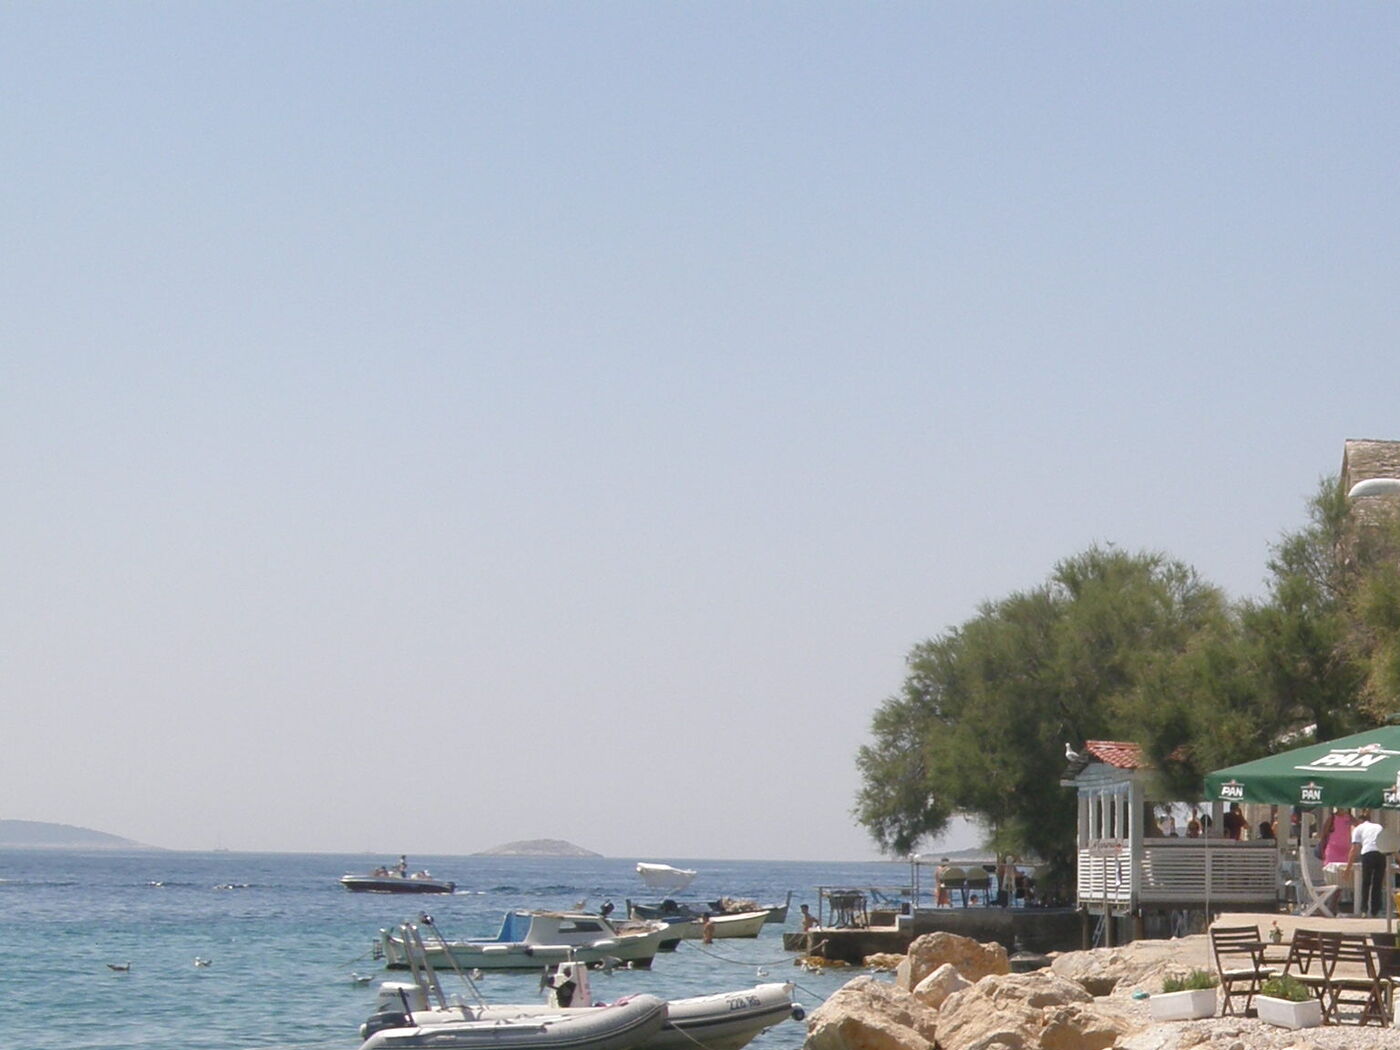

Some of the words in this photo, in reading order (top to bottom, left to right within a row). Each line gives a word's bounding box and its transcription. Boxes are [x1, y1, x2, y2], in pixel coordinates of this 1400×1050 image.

[1311, 753, 1388, 767] PAN
[1221, 786, 1244, 797] PAN
[1302, 789, 1321, 801] PAN
